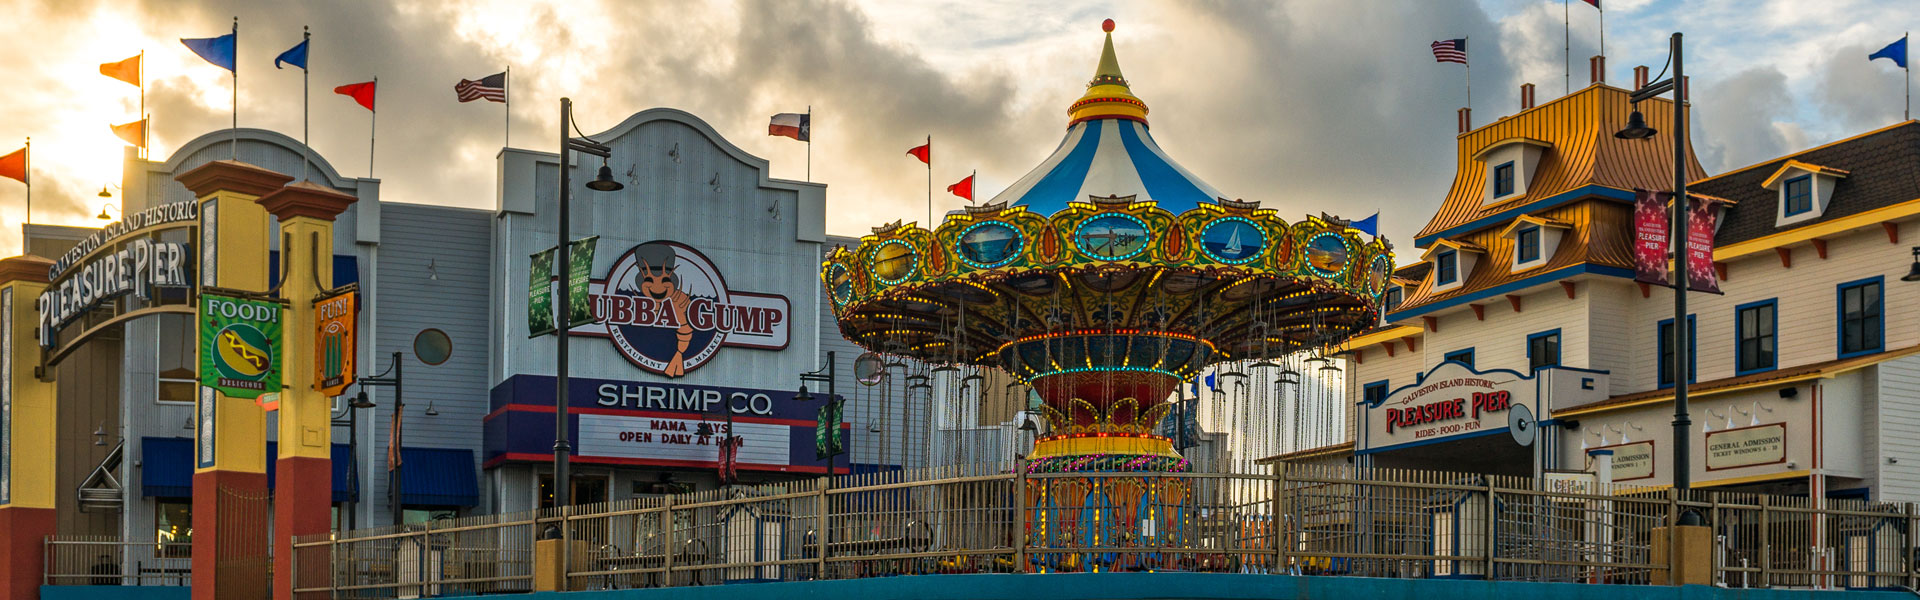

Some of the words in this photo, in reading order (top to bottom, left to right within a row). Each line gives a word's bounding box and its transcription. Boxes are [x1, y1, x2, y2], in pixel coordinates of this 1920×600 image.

[49, 229, 101, 282] GALVESTON
[104, 211, 142, 242] ISLAND
[144, 199, 198, 227] HISTORIC
[1638, 232, 1666, 243] PLEASURE
[1645, 241, 1659, 250] PIER
[1688, 241, 1711, 252] PLEASURE
[1694, 250, 1704, 259] PIER
[39, 249, 133, 347] PLEASURE
[135, 238, 188, 300] PIER
[207, 299, 278, 323] FOOD!
[320, 298, 348, 321] FUN!
[588, 293, 681, 328] UBBA
[687, 298, 783, 336] GUMP
[612, 328, 662, 369] RESTAURANT
[695, 333, 722, 363] MARKET
[221, 380, 263, 389] DELICIOUS
[1402, 383, 1438, 405] GALVESTON
[1440, 378, 1464, 389] ISLAND
[1464, 378, 1496, 390] HISTORIC
[598, 383, 722, 412] SHRIMP
[730, 392, 773, 416] CO.
[1386, 398, 1465, 434] PLEASURE
[1471, 390, 1511, 419] PIER
[650, 419, 687, 432] MAMA
[1415, 428, 1436, 439] RIDES
[1440, 424, 1460, 435] FOOD
[1465, 420, 1481, 431] FUN
[619, 431, 652, 443] OPEN
[661, 433, 692, 445] DAILY
[696, 433, 712, 446] AT
[1709, 441, 1740, 452] GENERAL
[1743, 436, 1781, 448] ADMISSION
[1617, 453, 1650, 463] ADMISSION
[1713, 450, 1731, 458] TICKET
[1734, 447, 1761, 455] WINDOWS
